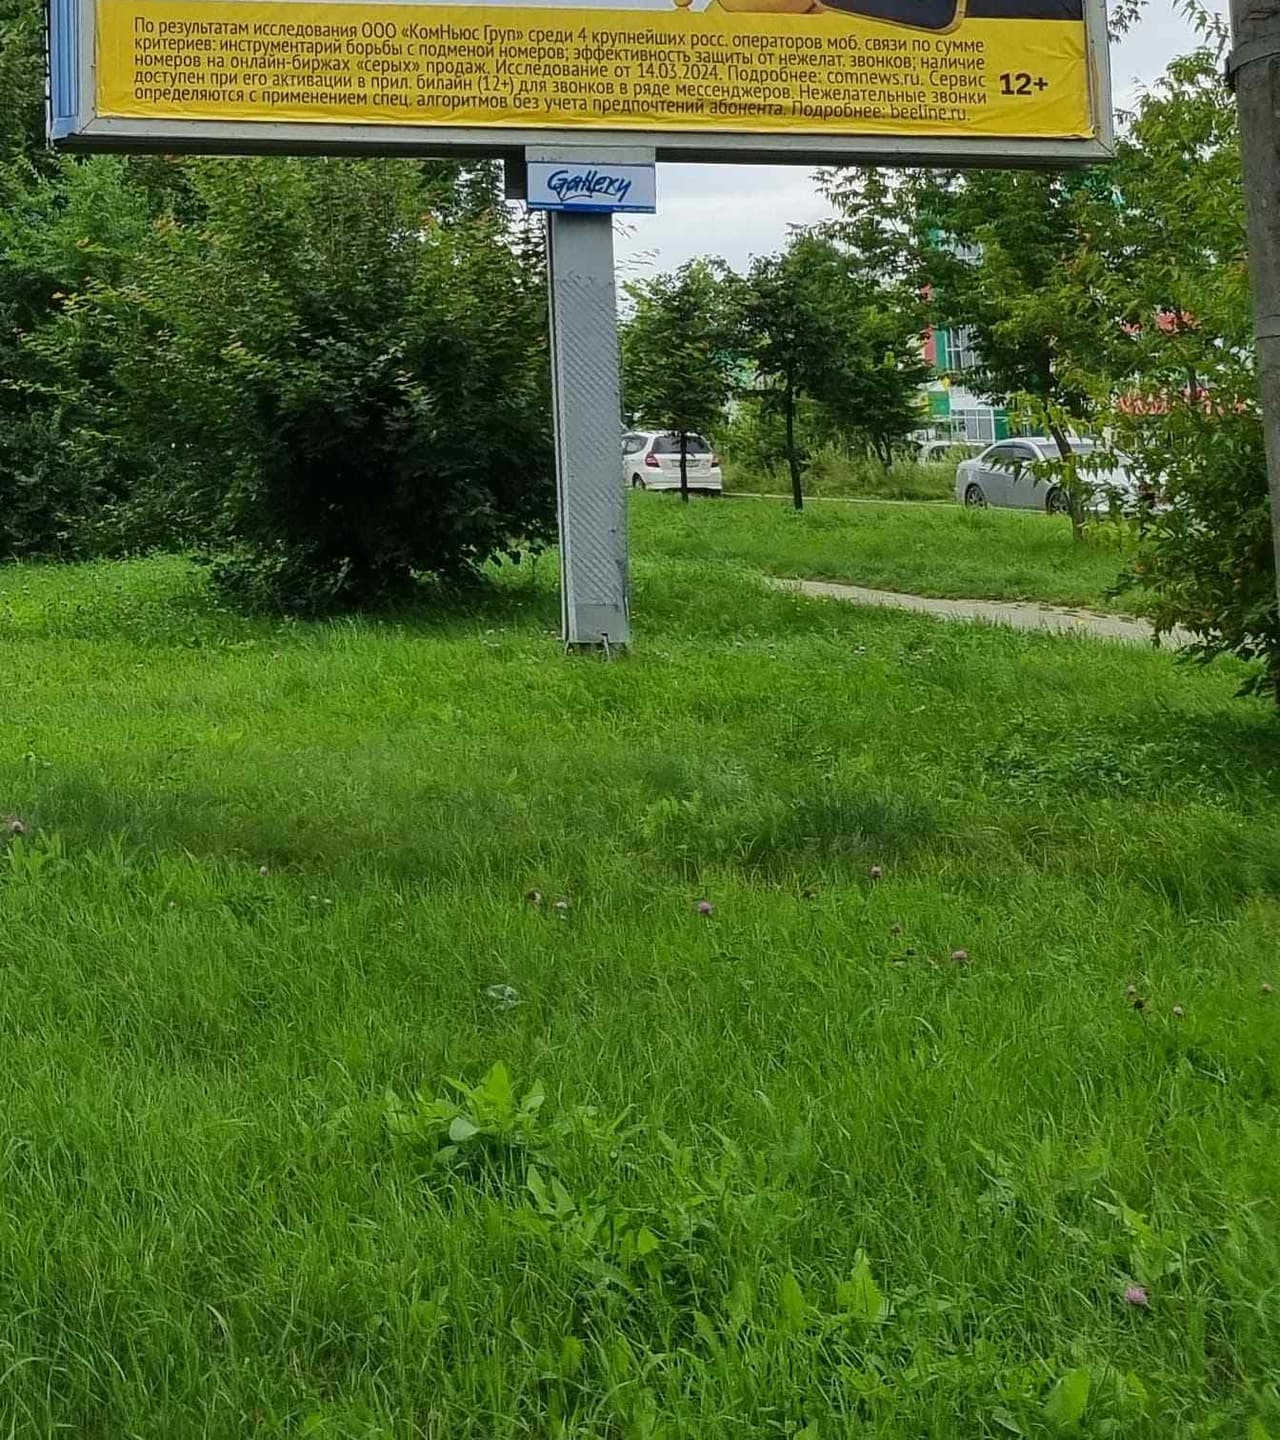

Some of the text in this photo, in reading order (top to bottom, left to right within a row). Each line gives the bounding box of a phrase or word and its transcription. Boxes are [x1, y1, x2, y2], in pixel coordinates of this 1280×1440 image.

[134, 17, 983, 55] По результатам исследования ООО «КомНьюс Груп» среди 4 крупнейших росс. операторов моб. связи по сумме
[134, 37, 984, 71] критериев: инструментарий борьбы с подменой номеров; эффективность защиты от нежелат. звонков; наличие
[134, 54, 201, 71] номеров
[208, 56, 224, 67] на
[231, 55, 350, 73] онлайн-биржах
[357, 60, 420, 75] «серых»
[426, 61, 490, 76] продаж.
[496, 60, 608, 78] Исследование
[614, 66, 630, 77] от
[640, 62, 722, 80] 14.03.2024.
[728, 65, 821, 84] Подробнее:
[930, 72, 986, 89] Сервис
[134, 70, 986, 104] доступен при его активации в прил. билайн (12+) для звонков в ряде мессенджеров. Нежелательные звонки
[1000, 73, 1048, 95] 12+
[134, 87, 244, 103] определяются
[250, 90, 256, 102] с
[263, 90, 367, 106] применением
[373, 94, 412, 108] спец.
[417, 95, 507, 111] алгоритмов
[513, 94, 539, 109] без
[546, 97, 587, 113] учета
[593, 97, 704, 114] предпочтений
[710, 99, 786, 115] абонента.
[792, 102, 885, 120] Подробнее:
[547, 170, 631, 202] Gallery
